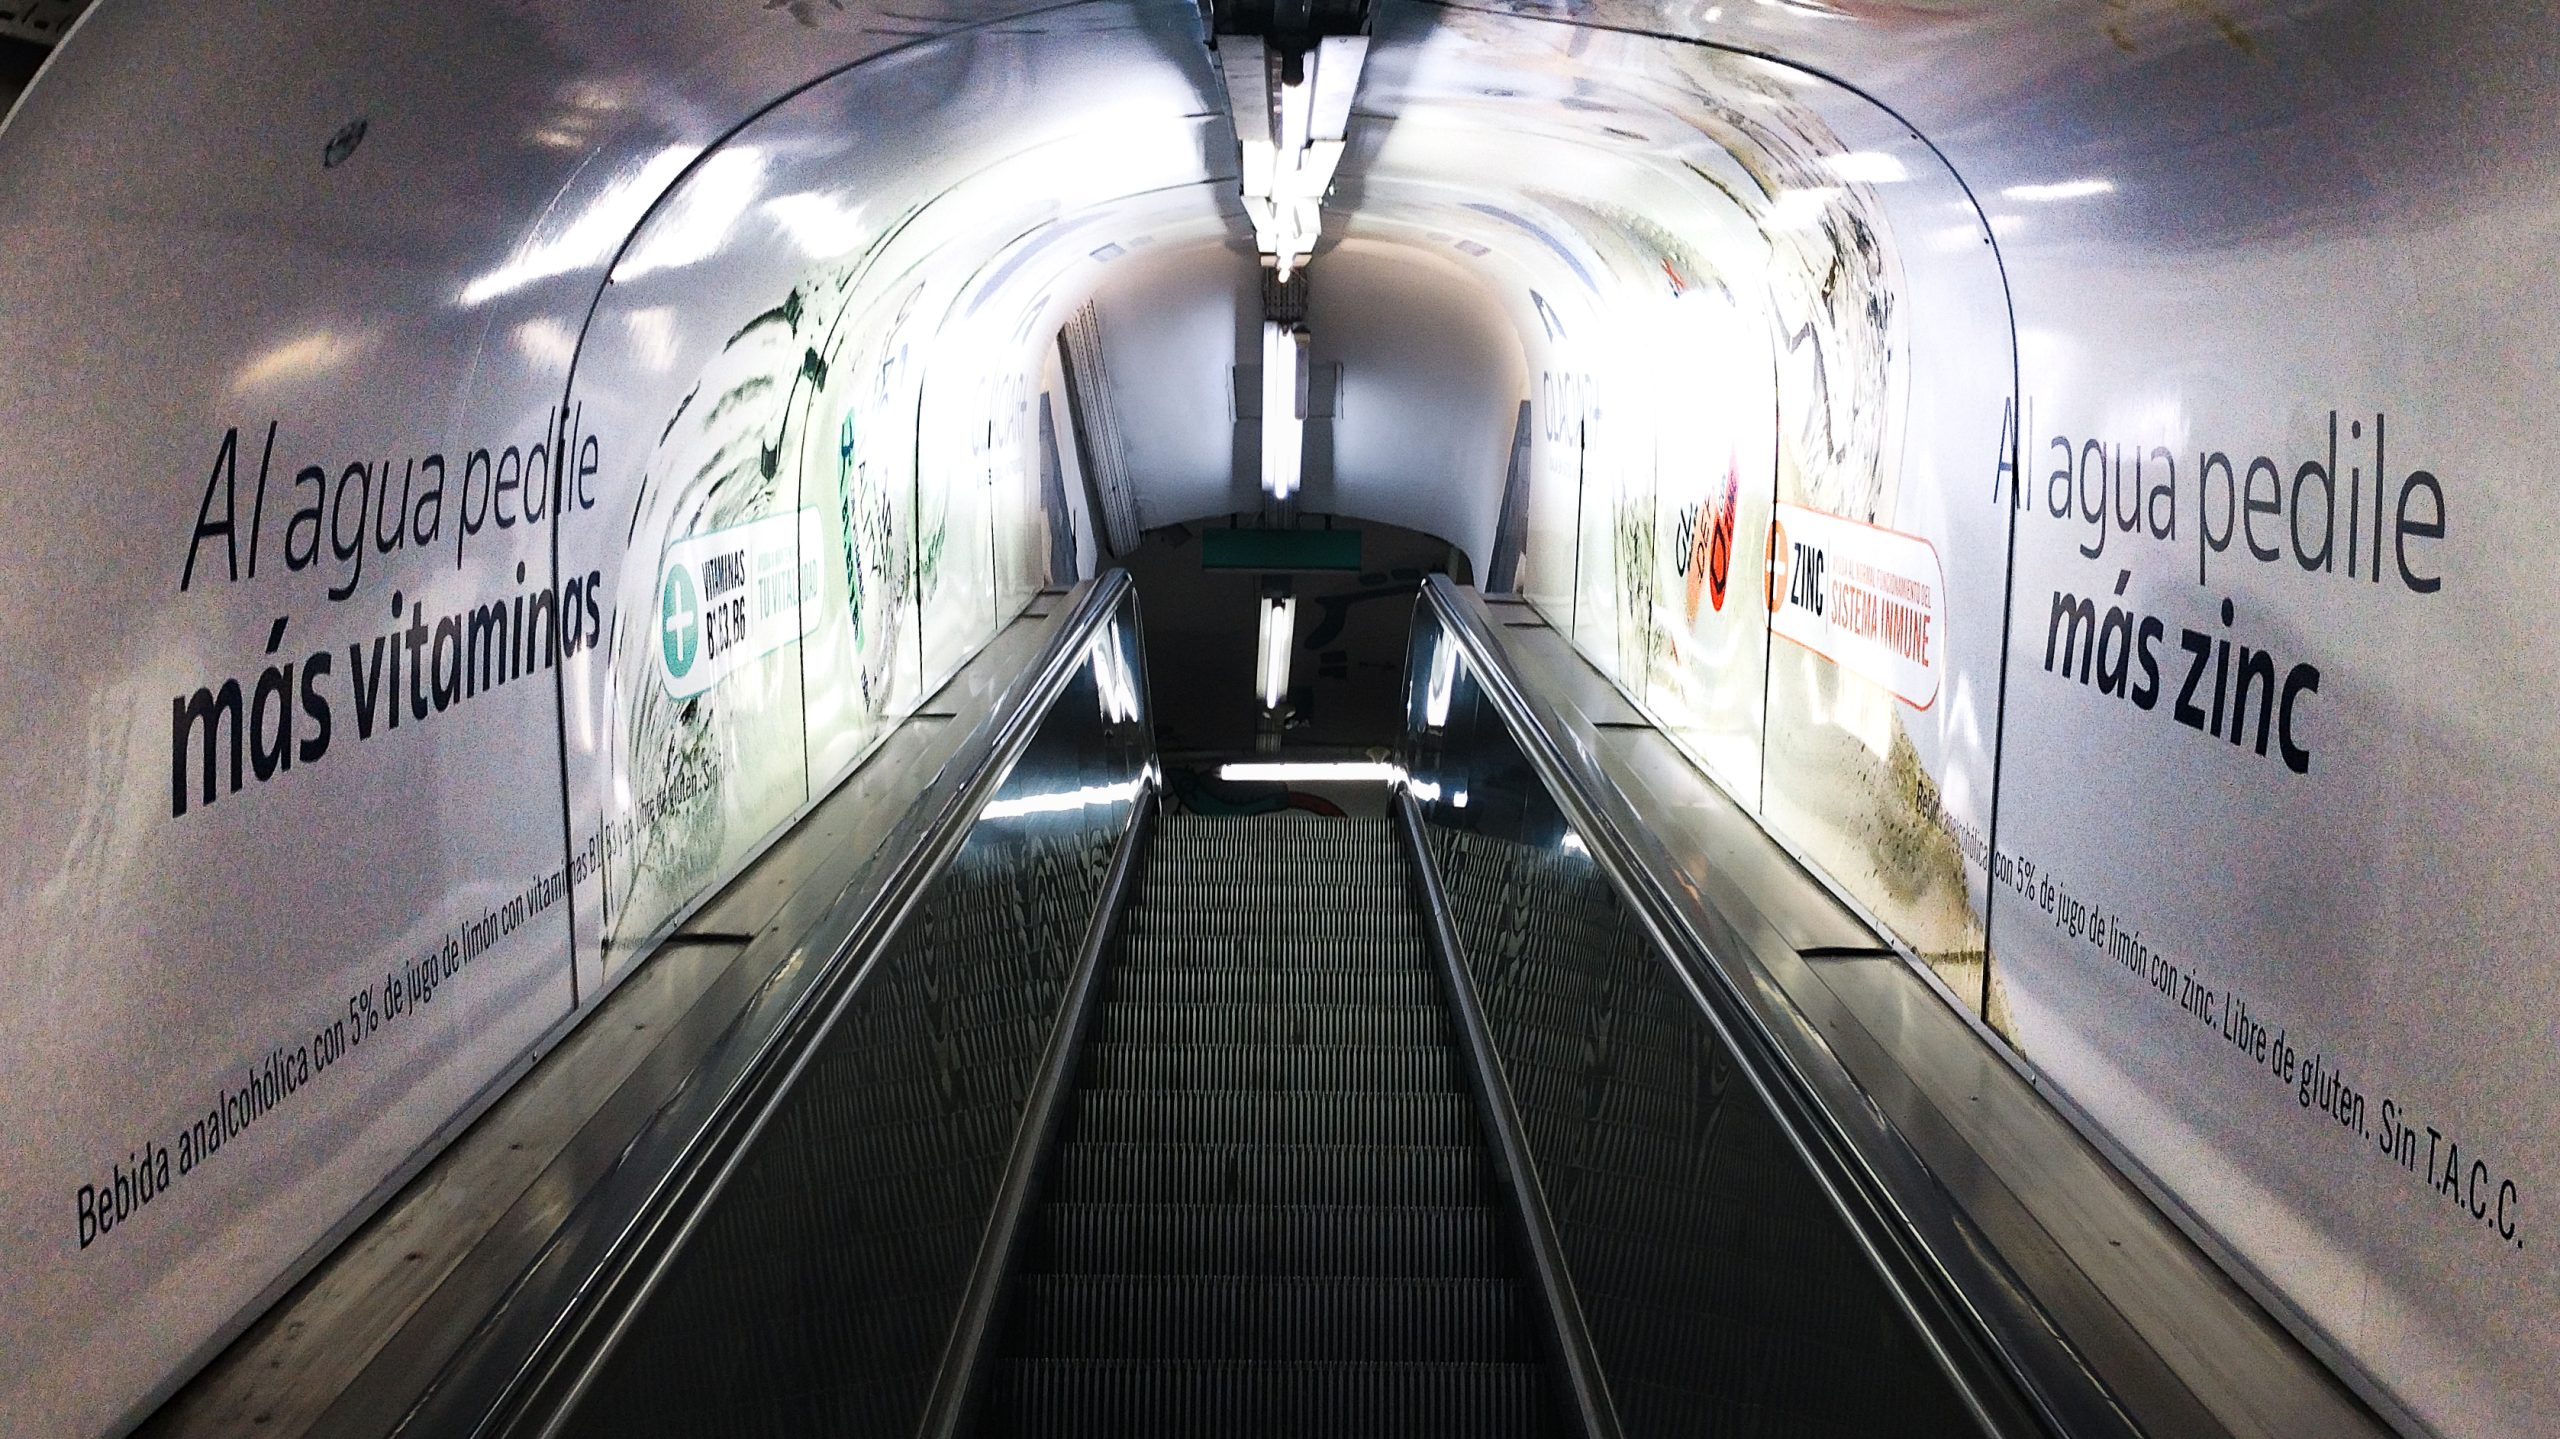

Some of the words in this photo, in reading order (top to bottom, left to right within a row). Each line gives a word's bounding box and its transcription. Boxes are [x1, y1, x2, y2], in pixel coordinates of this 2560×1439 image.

[180, 421, 278, 592] Al
[284, 454, 446, 600] agua
[457, 402, 600, 569] pedile
[702, 549, 745, 602] VITAMINAS
[1791, 542, 1824, 617] ZINC
[1994, 395, 2033, 511] Al
[2048, 435, 2176, 560] agua
[2200, 410, 2446, 594] pedile
[172, 616, 331, 818] más
[349, 562, 600, 741] vitaminas
[733, 596, 745, 643] B6
[758, 576, 769, 620] TU
[1831, 580, 1878, 640] SISTEMA
[1881, 598, 1931, 668] INMUNE
[2044, 569, 2164, 711] más
[2174, 597, 2320, 774] zinc
[77, 1143, 169, 1250] Bebida
[178, 1046, 310, 1175] analcohólica
[313, 1022, 346, 1071] con
[349, 984, 378, 1046] 5%
[383, 979, 404, 1023] de
[406, 954, 439, 1014] jugo
[442, 935, 459, 979] de
[462, 908, 499, 965] limón
[501, 897, 524, 937] con
[527, 852, 587, 917] vitaminas
[703, 760, 718, 791] Sin
[1995, 851, 2013, 887] con
[2017, 856, 2036, 901] 5%
[2040, 873, 2055, 913] de
[2056, 882, 2085, 938] jugo
[2089, 904, 2105, 949] de
[2108, 914, 2147, 979] limón
[2151, 953, 2178, 999] con
[2181, 969, 2217, 1028] zinc.
[2223, 991, 2267, 1063] Libre
[2271, 1030, 2294, 1084] de
[2299, 1054, 2371, 1140] gluten.
[2380, 1099, 2416, 1171] Sin
[2426, 1126, 2524, 1249] T.A.C.C.
